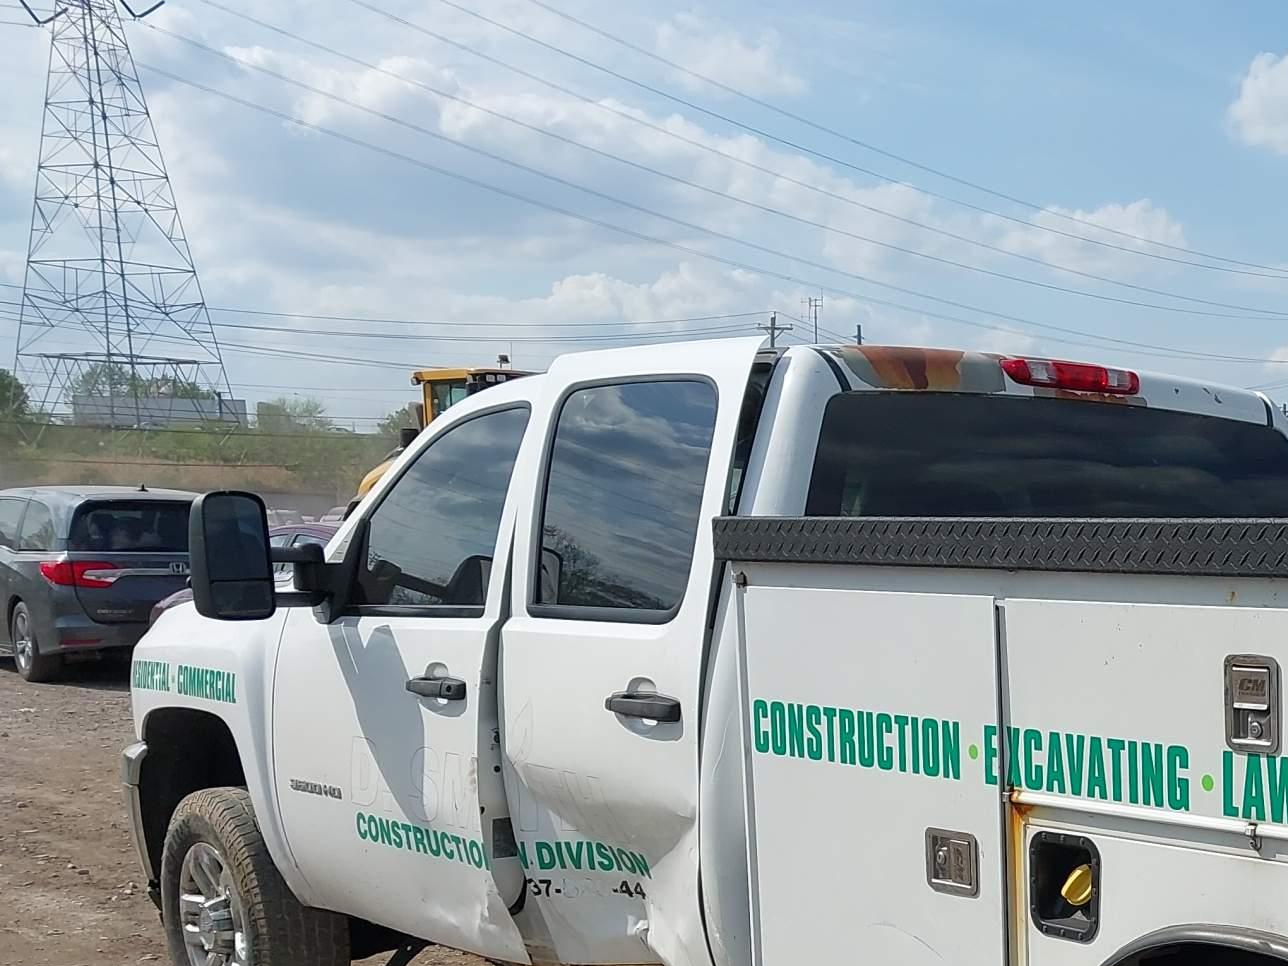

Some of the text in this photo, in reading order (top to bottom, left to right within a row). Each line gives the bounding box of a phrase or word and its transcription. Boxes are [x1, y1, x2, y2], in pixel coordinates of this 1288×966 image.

[177, 664, 236, 704] COMMERCIAL
[751, 697, 963, 781] CONSTRUCTION
[982, 723, 1192, 813] EXCAVATING
[535, 840, 652, 880] DIVISION
